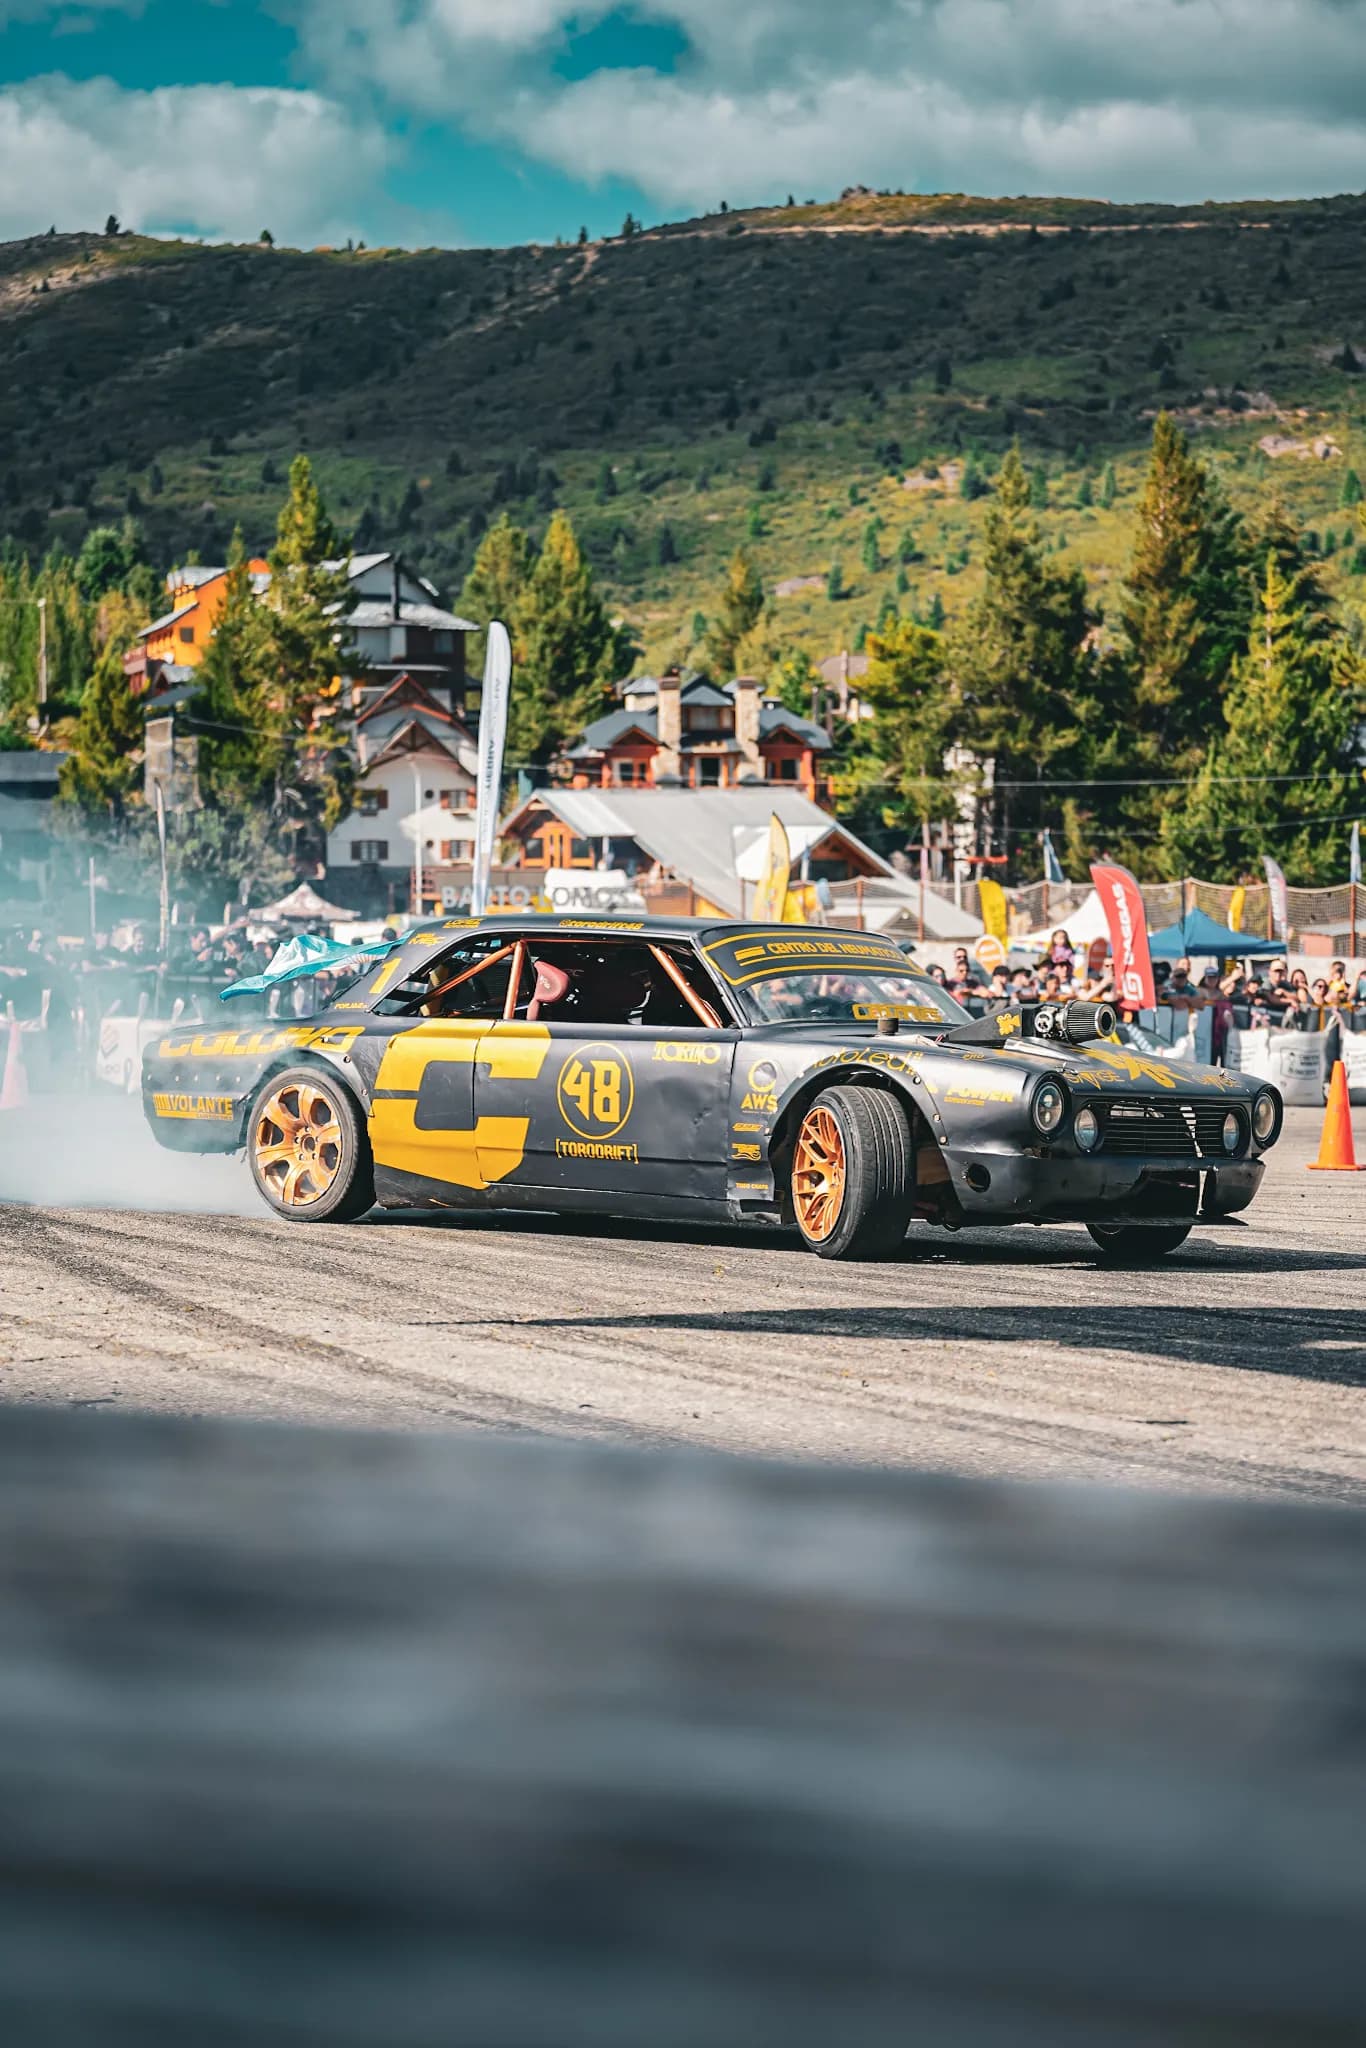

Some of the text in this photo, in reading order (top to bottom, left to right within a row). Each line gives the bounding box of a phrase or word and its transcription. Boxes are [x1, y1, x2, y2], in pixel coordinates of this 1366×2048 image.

[767, 942, 818, 954] CENTRO
[815, 942, 841, 953] DEL
[561, 1060, 621, 1123] 48
[168, 1093, 233, 1115] VOLANTE
[740, 1093, 779, 1113] AWS
